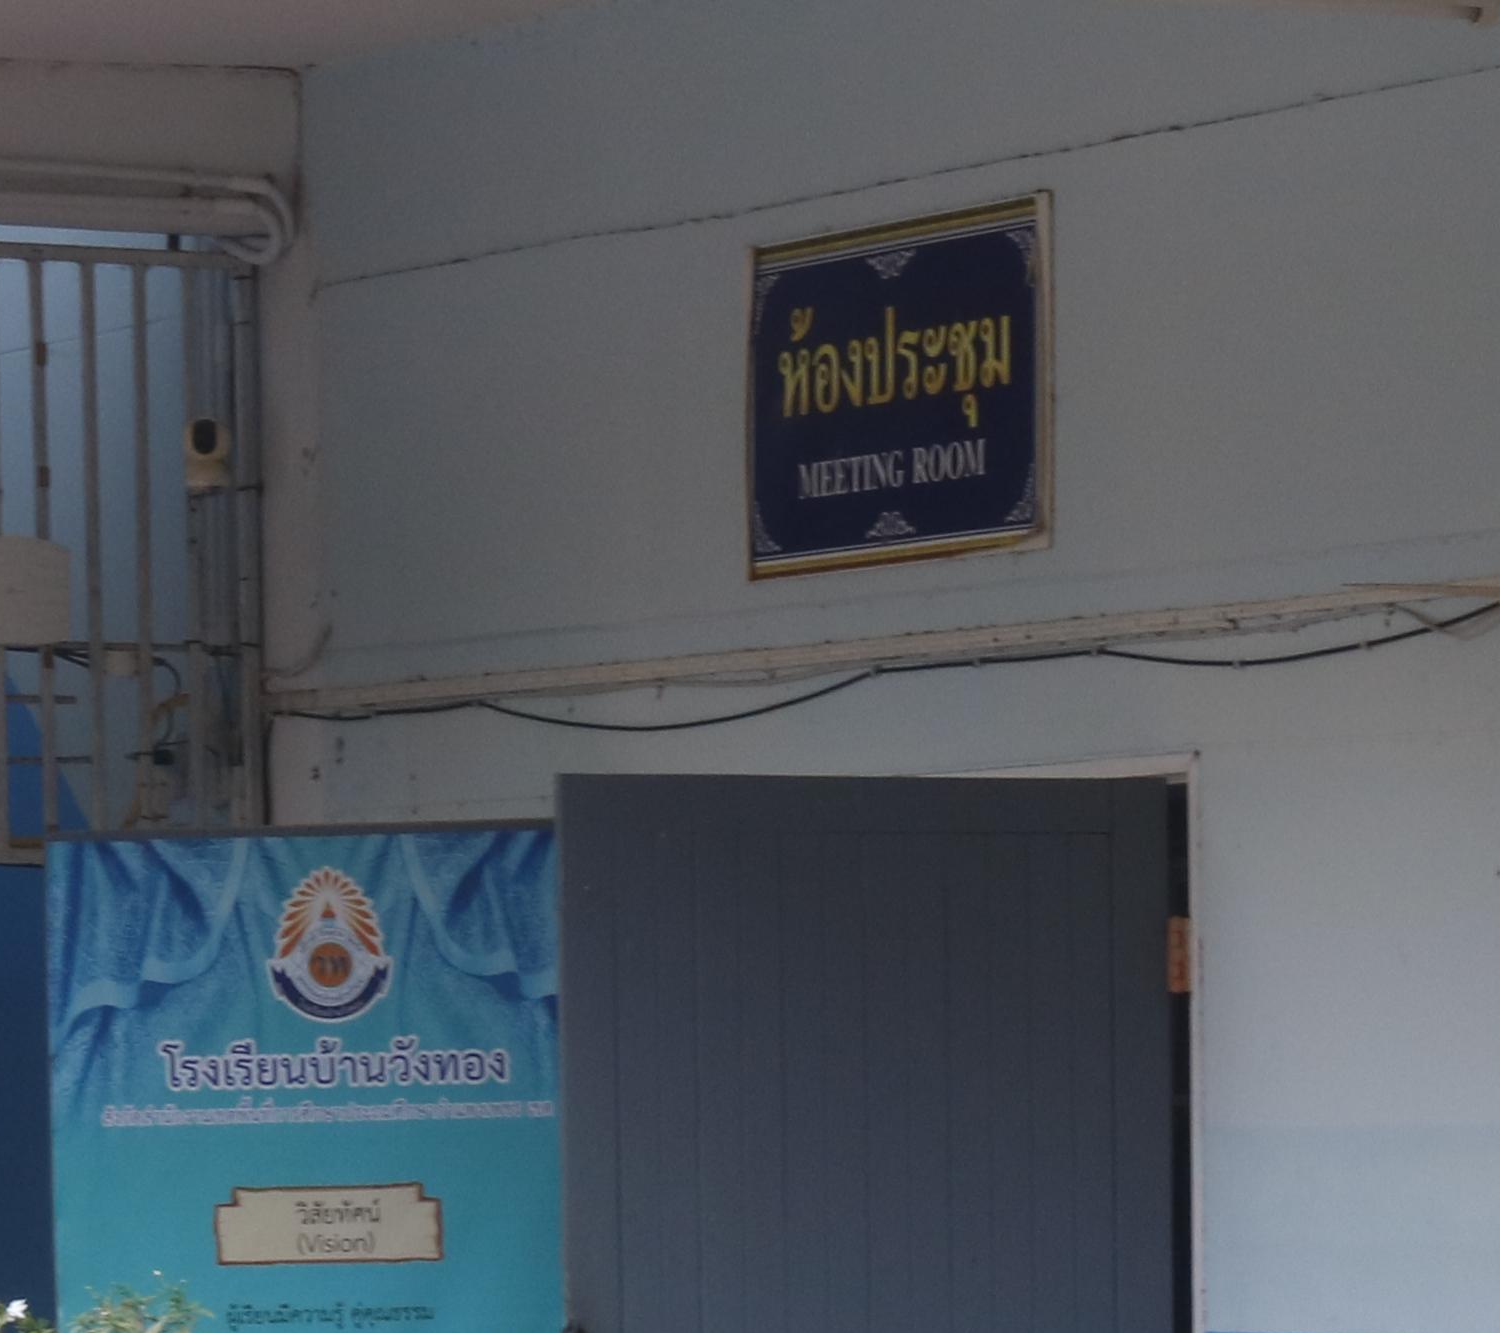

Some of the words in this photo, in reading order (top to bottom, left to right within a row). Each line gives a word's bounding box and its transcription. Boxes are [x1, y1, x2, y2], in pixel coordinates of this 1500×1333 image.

[778, 305, 1012, 428] ห้องประชุม
[798, 448, 904, 499] MEETING
[911, 438, 987, 484] ROOM
[161, 1037, 506, 1089] โรงเรียนบ้านวังทอง
[297, 1231, 375, 1256] (Vision)
